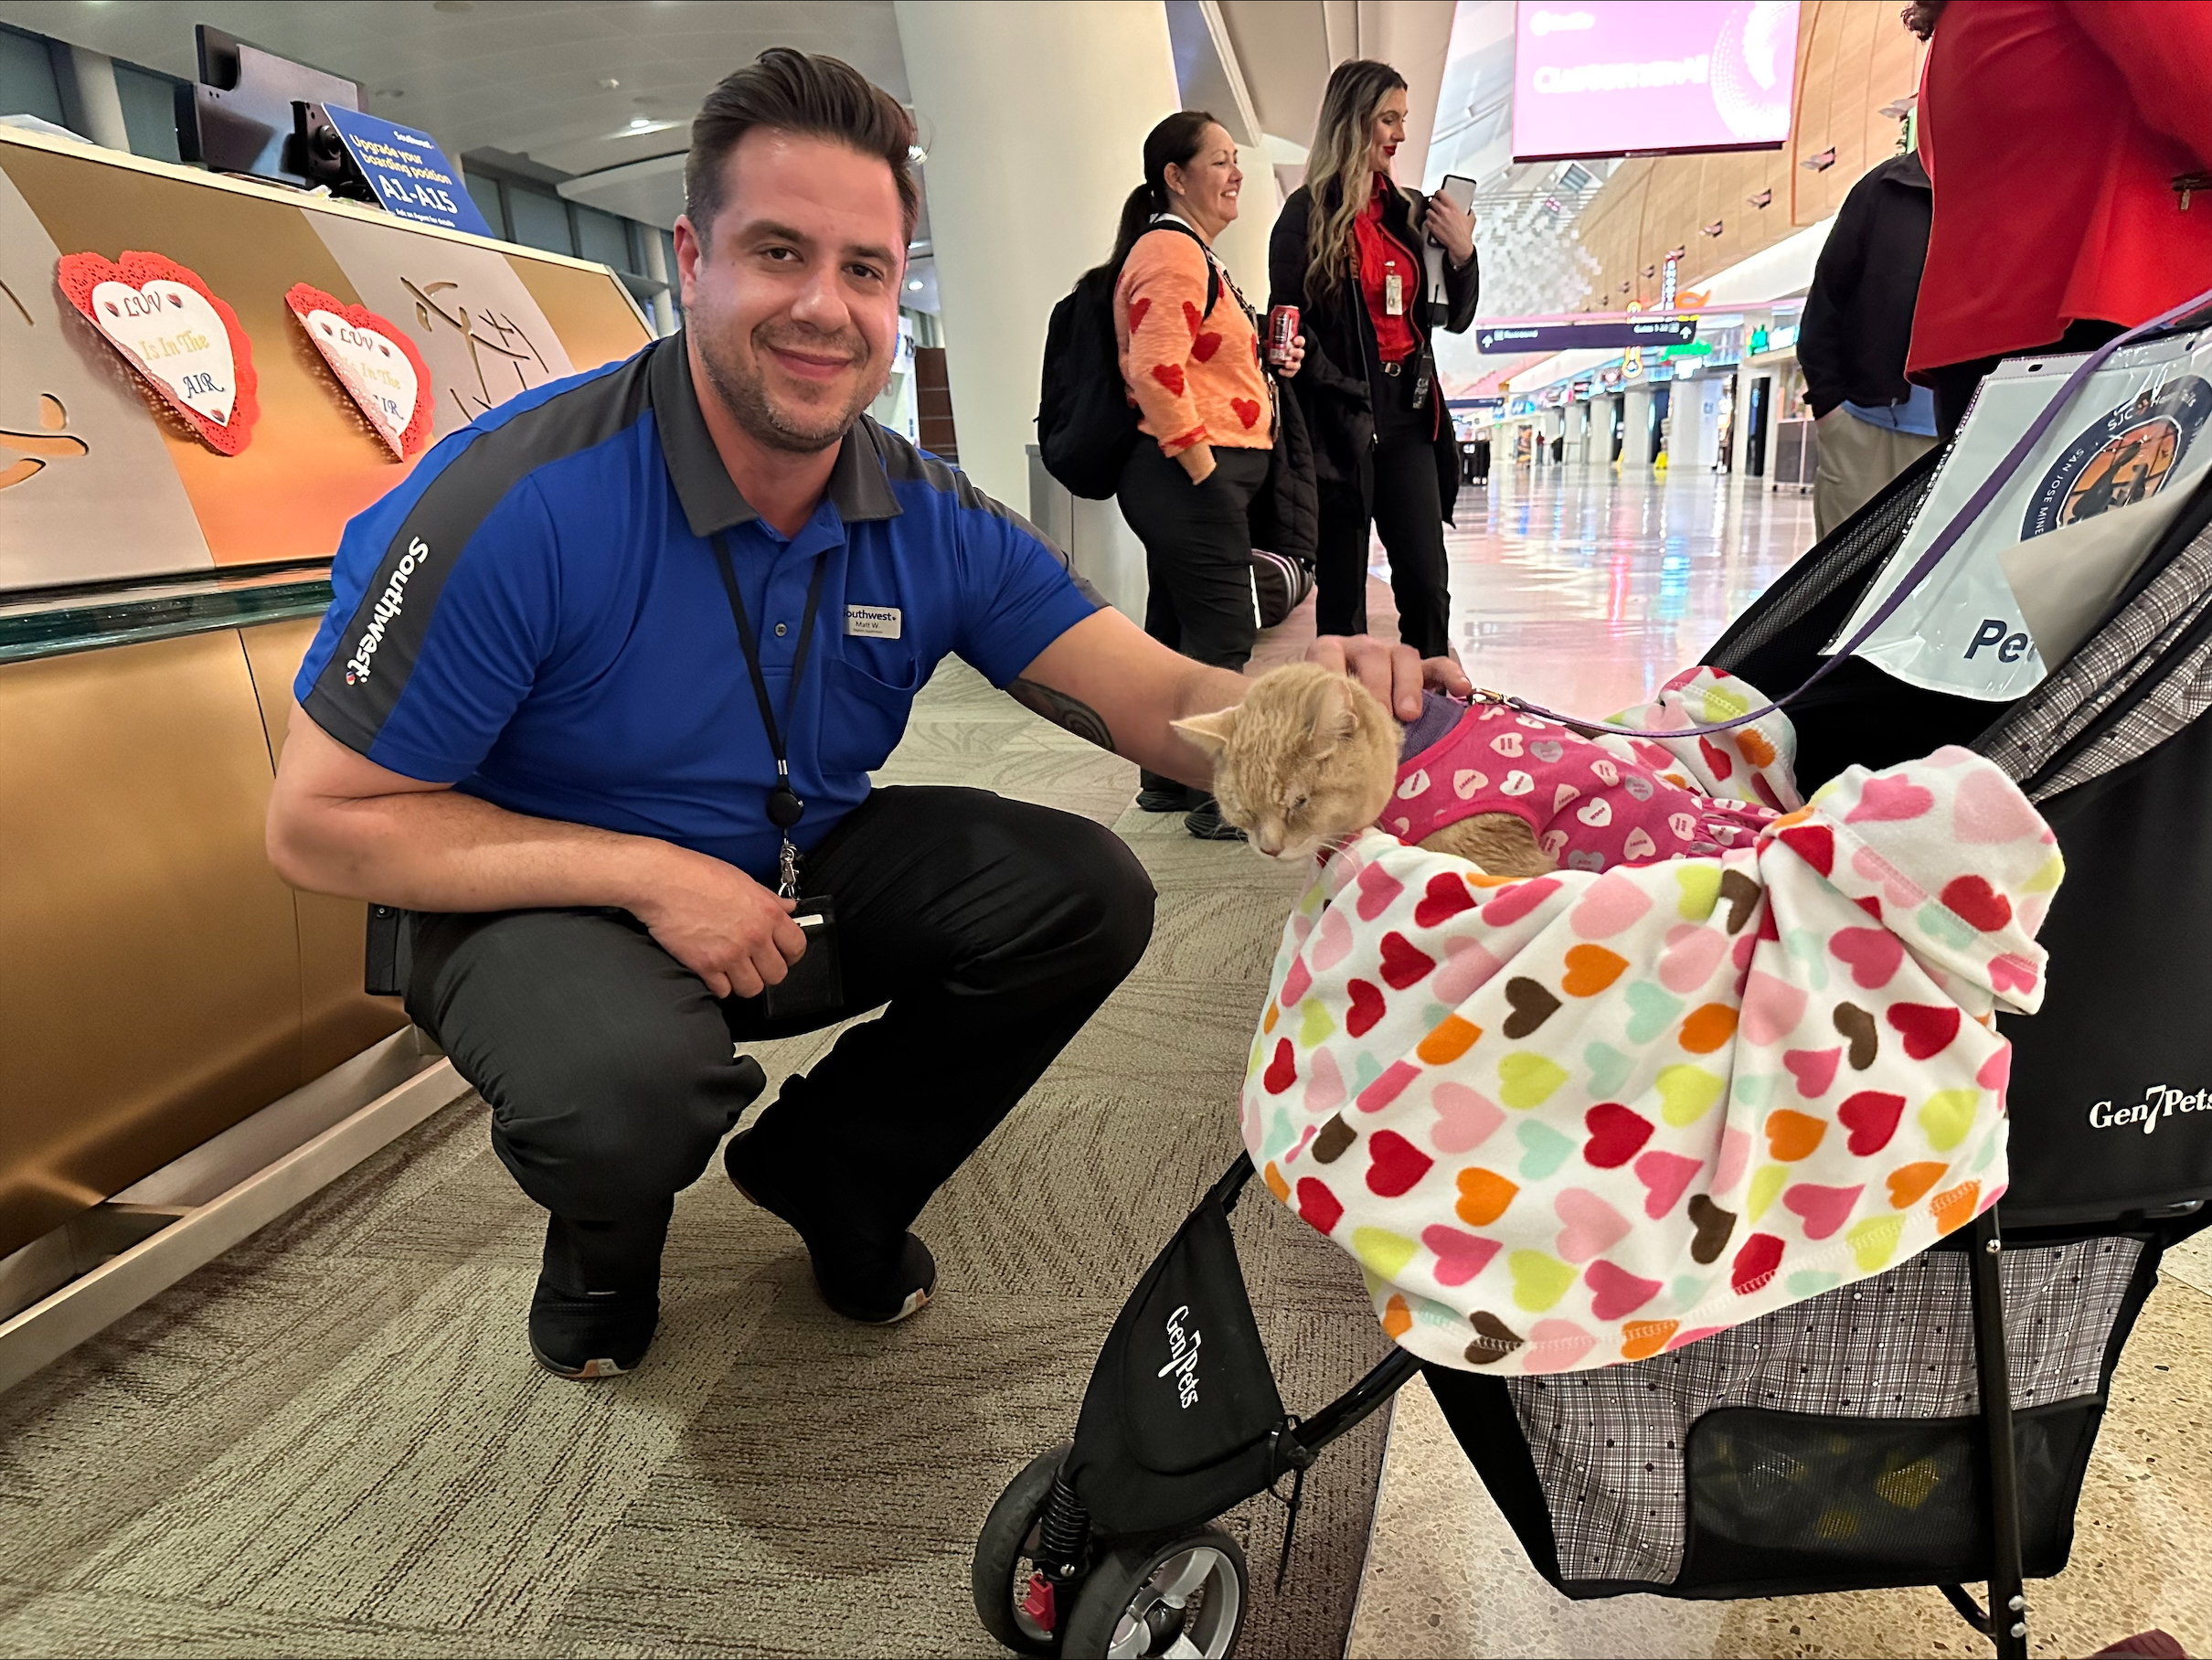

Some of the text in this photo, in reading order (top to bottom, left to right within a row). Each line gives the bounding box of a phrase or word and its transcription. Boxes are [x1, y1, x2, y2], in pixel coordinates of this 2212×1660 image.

[349, 133, 423, 165] Upgrade your
[358, 149, 452, 186] boarding position
[378, 175, 458, 214] A1-A15
[123, 291, 162, 317] LUV
[139, 329, 210, 361] Is In The
[340, 328, 373, 351] LUV
[183, 372, 225, 399] AIR
[2107, 407, 2134, 432] SJC
[2062, 448, 2084, 472] SAN
[2043, 474, 2064, 503] JOSE
[346, 536, 430, 679] Southwest
[856, 621, 871, 629] Matt
[1157, 1305, 1202, 1409] Gen7Pets
